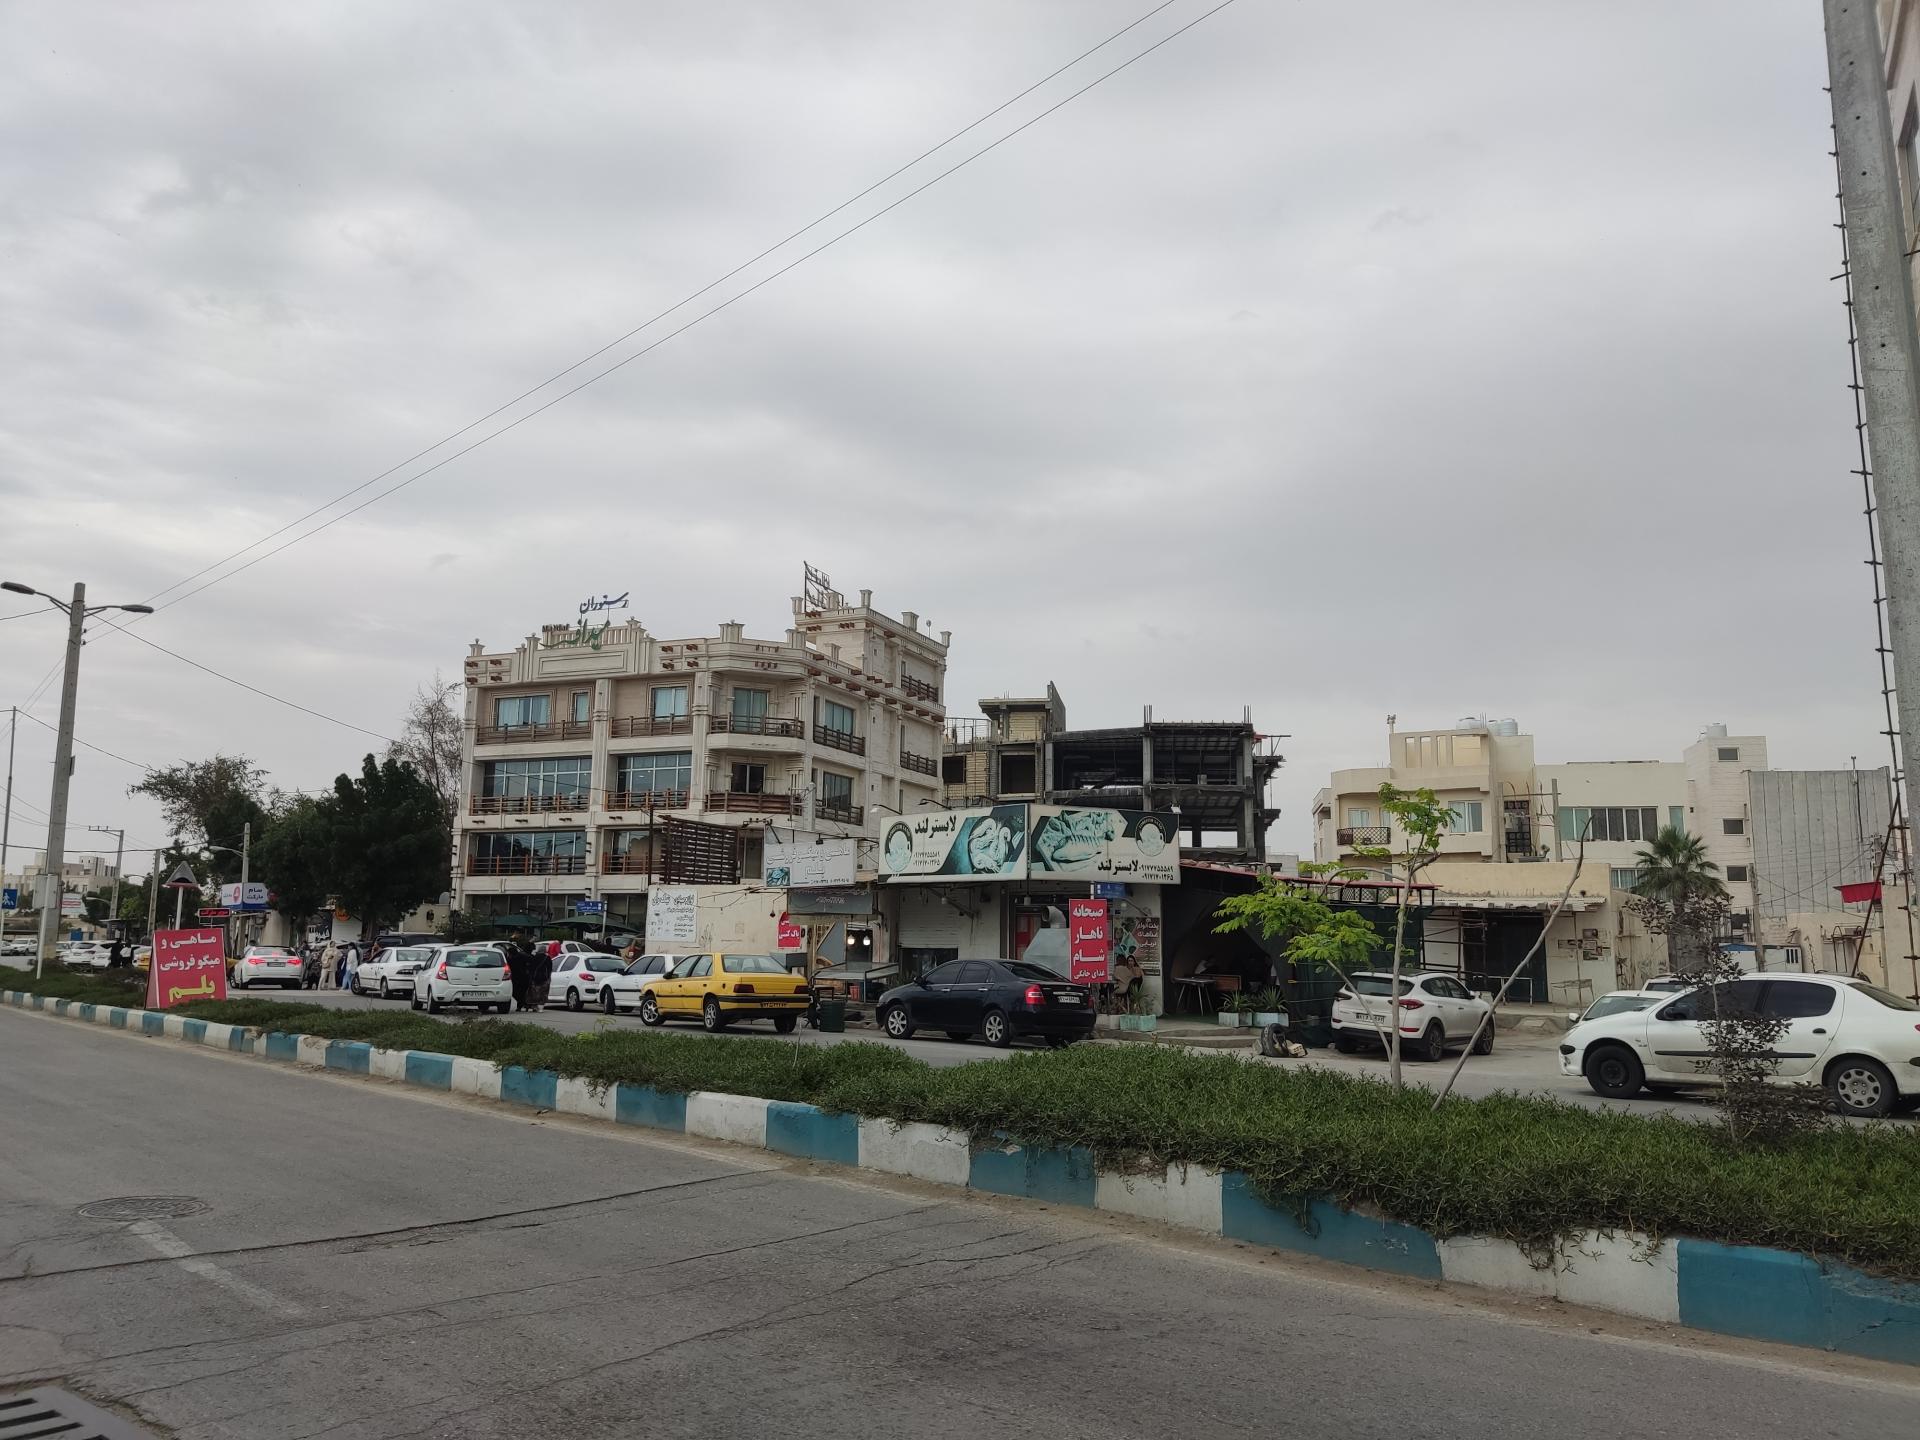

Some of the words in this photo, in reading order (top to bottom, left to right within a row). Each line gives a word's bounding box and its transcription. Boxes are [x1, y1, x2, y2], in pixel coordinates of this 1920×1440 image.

[579, 592, 629, 614] رستوران
[1073, 904, 1103, 920] صبحانه
[160, 938, 167, 949] و
[170, 932, 217, 949] ماهی
[1074, 926, 1103, 944] ناهار
[160, 953, 195, 971] فروشی
[196, 954, 221, 970] میگو
[1073, 948, 1105, 966] شام
[1074, 969, 1090, 980] خانگی
[1091, 970, 1105, 978] غذای
[169, 974, 216, 1003] بلم
